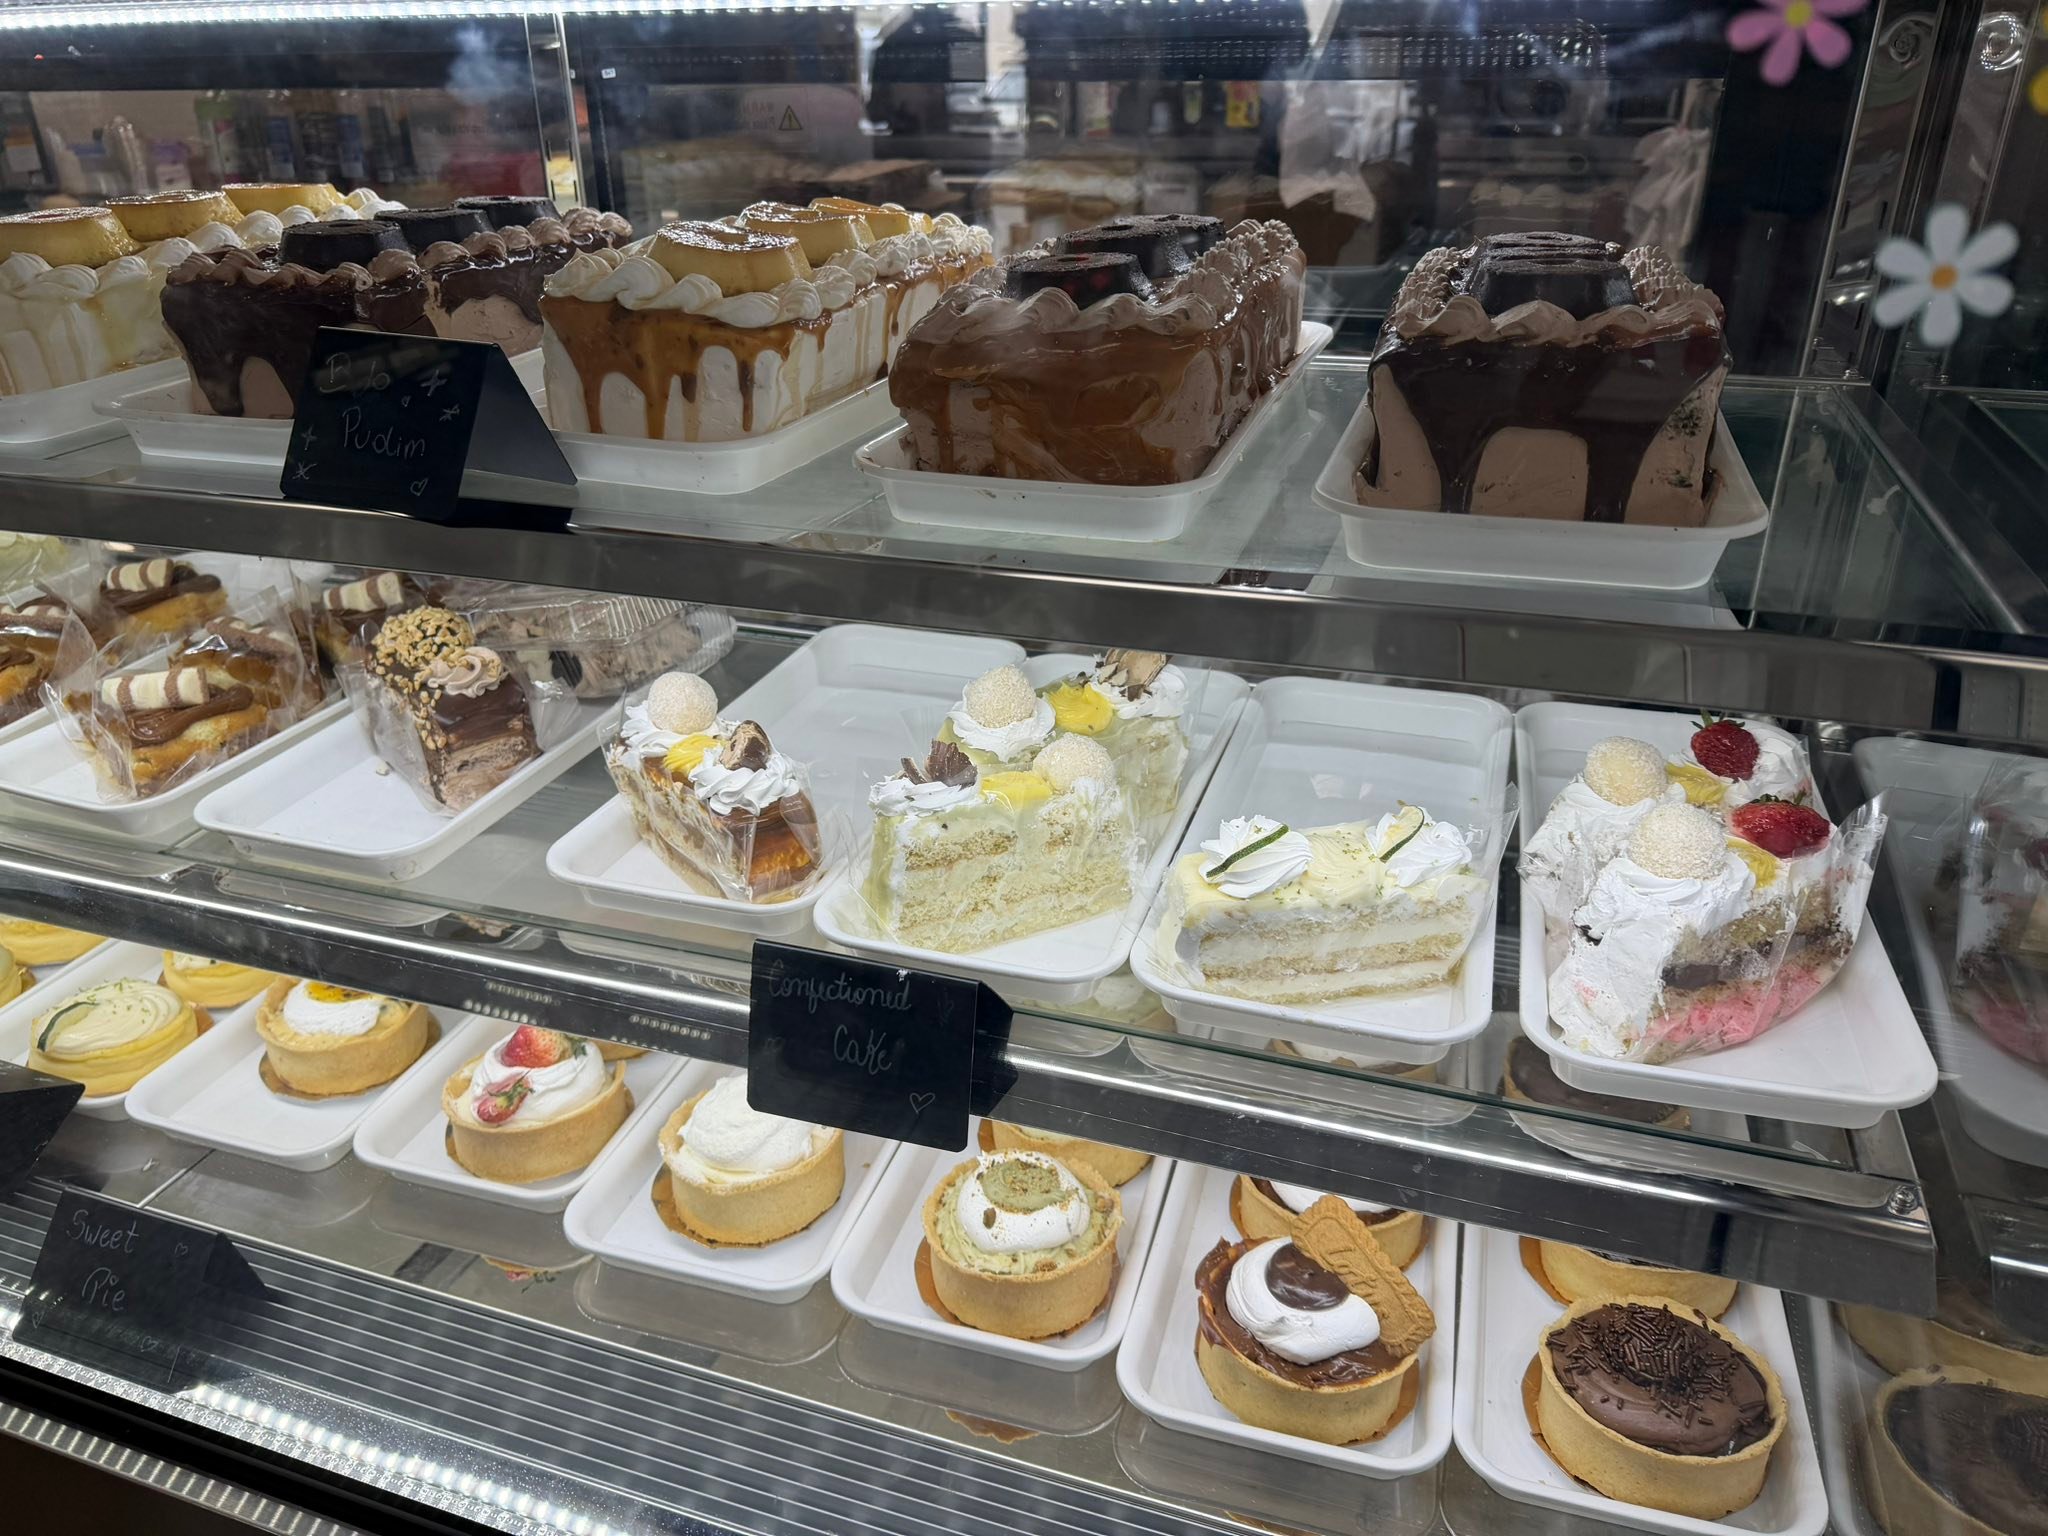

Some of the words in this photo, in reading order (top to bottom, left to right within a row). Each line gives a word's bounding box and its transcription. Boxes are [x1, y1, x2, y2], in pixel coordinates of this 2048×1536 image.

[318, 351, 391, 395] Blo
[341, 405, 425, 458] Pudim
[767, 959, 912, 1014] Confectioned
[832, 1023, 893, 1076] Cake
[64, 1209, 140, 1254] Sweet
[81, 1266, 127, 1312] Pie
